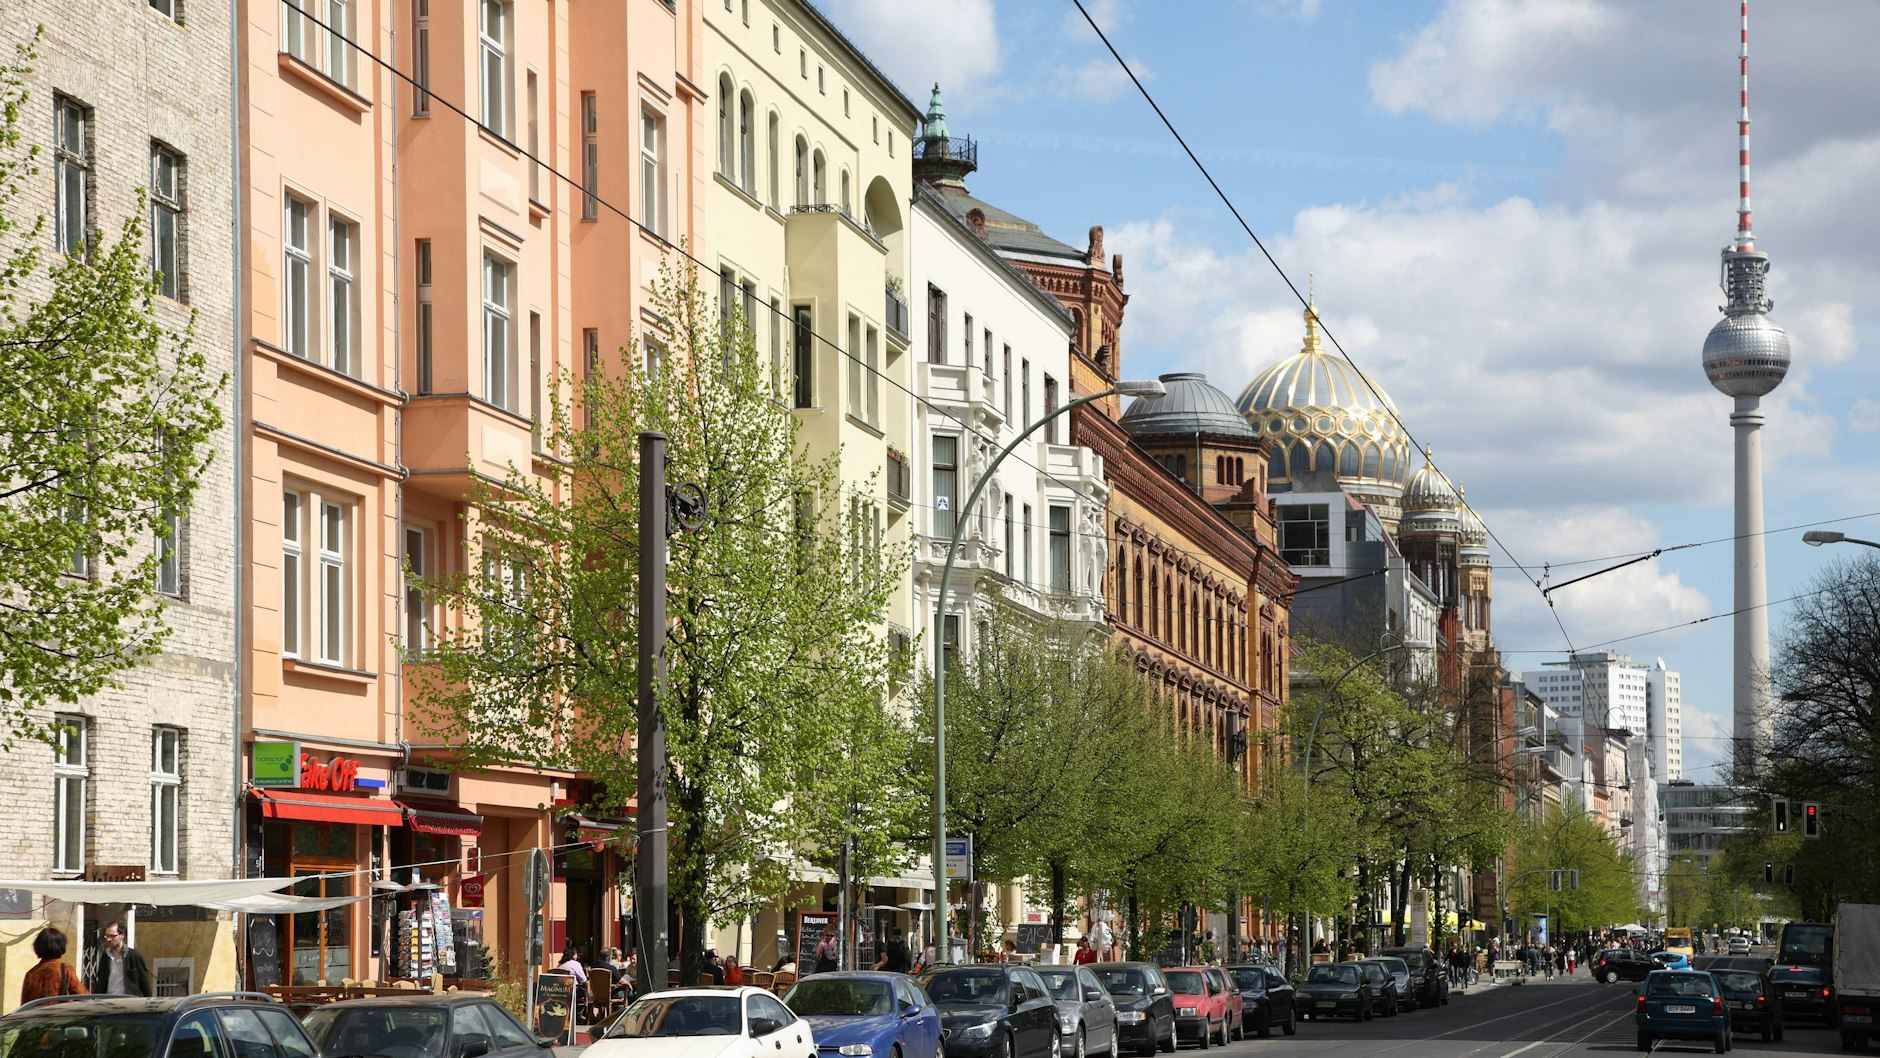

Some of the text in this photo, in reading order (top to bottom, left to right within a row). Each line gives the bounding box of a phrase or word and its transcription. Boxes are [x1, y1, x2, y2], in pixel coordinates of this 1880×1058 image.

[332, 756, 361, 792] Off
[803, 915, 829, 924] BERLINER
[540, 985, 571, 993] MAGNUM
